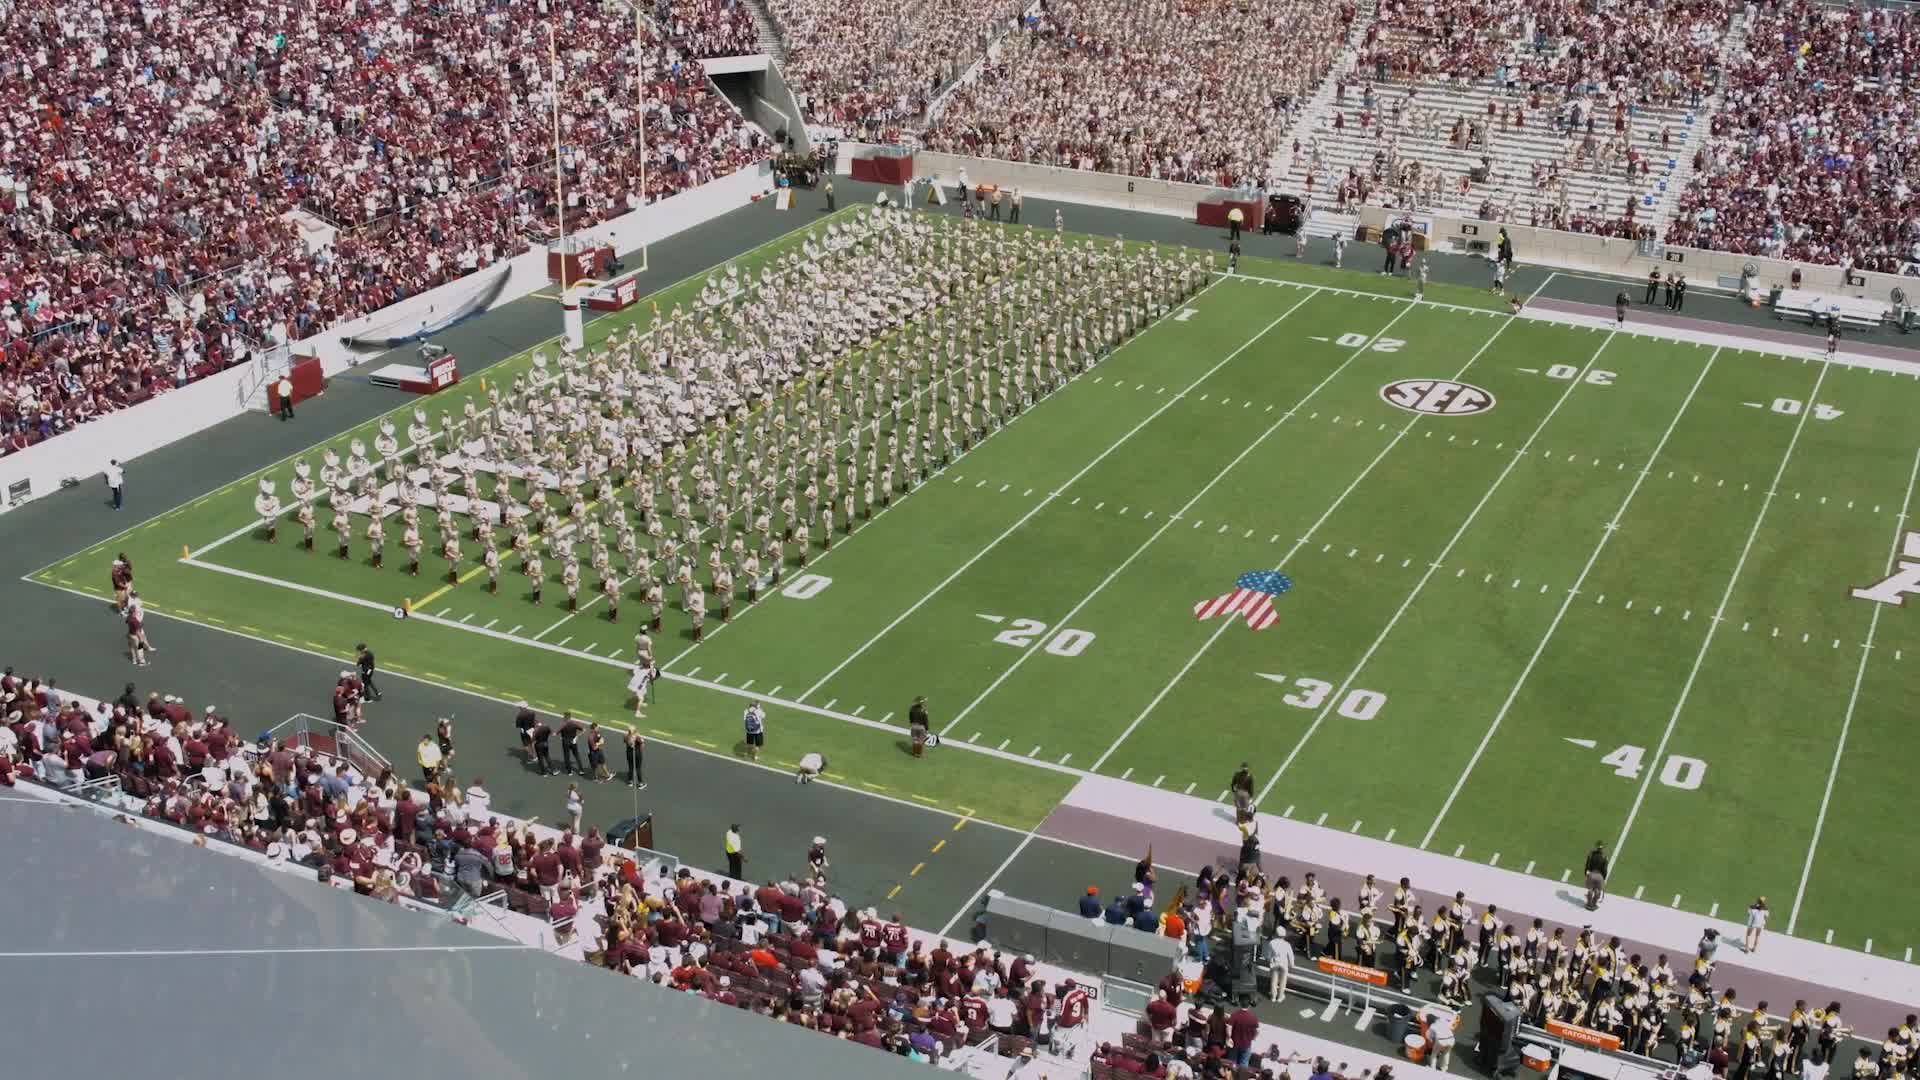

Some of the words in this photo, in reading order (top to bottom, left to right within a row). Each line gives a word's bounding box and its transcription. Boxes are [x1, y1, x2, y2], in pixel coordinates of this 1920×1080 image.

[1335, 332, 1406, 352] 20
[1545, 364, 1617, 385] 30
[1386, 380, 1490, 414] SEC
[1770, 397, 1845, 420] 40
[992, 618, 1096, 656] 20
[1282, 677, 1388, 720] 30
[1600, 744, 1707, 790] 40
[1071, 1001, 1081, 1017] 9
